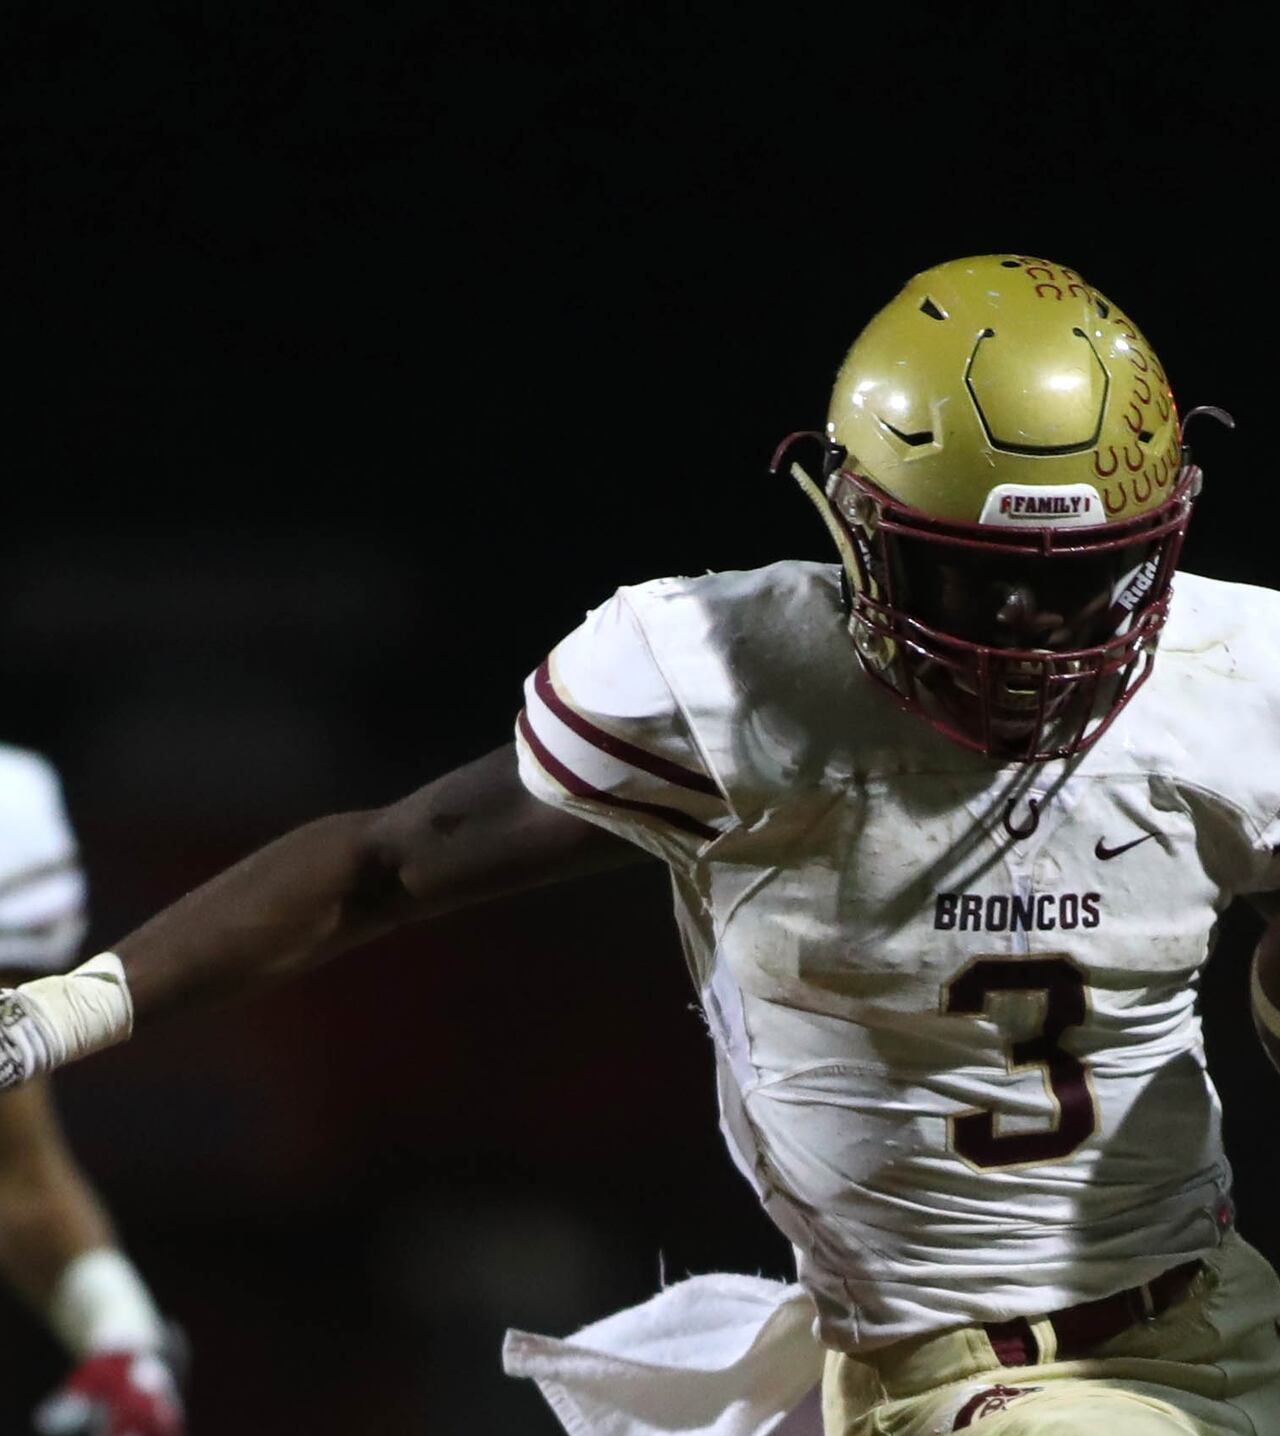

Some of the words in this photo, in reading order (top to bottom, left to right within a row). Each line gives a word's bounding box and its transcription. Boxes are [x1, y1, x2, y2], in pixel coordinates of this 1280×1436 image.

[1014, 496, 1082, 513] FAMILY
[934, 893, 1102, 932] BRONCOS
[939, 952, 1102, 1174] 3
